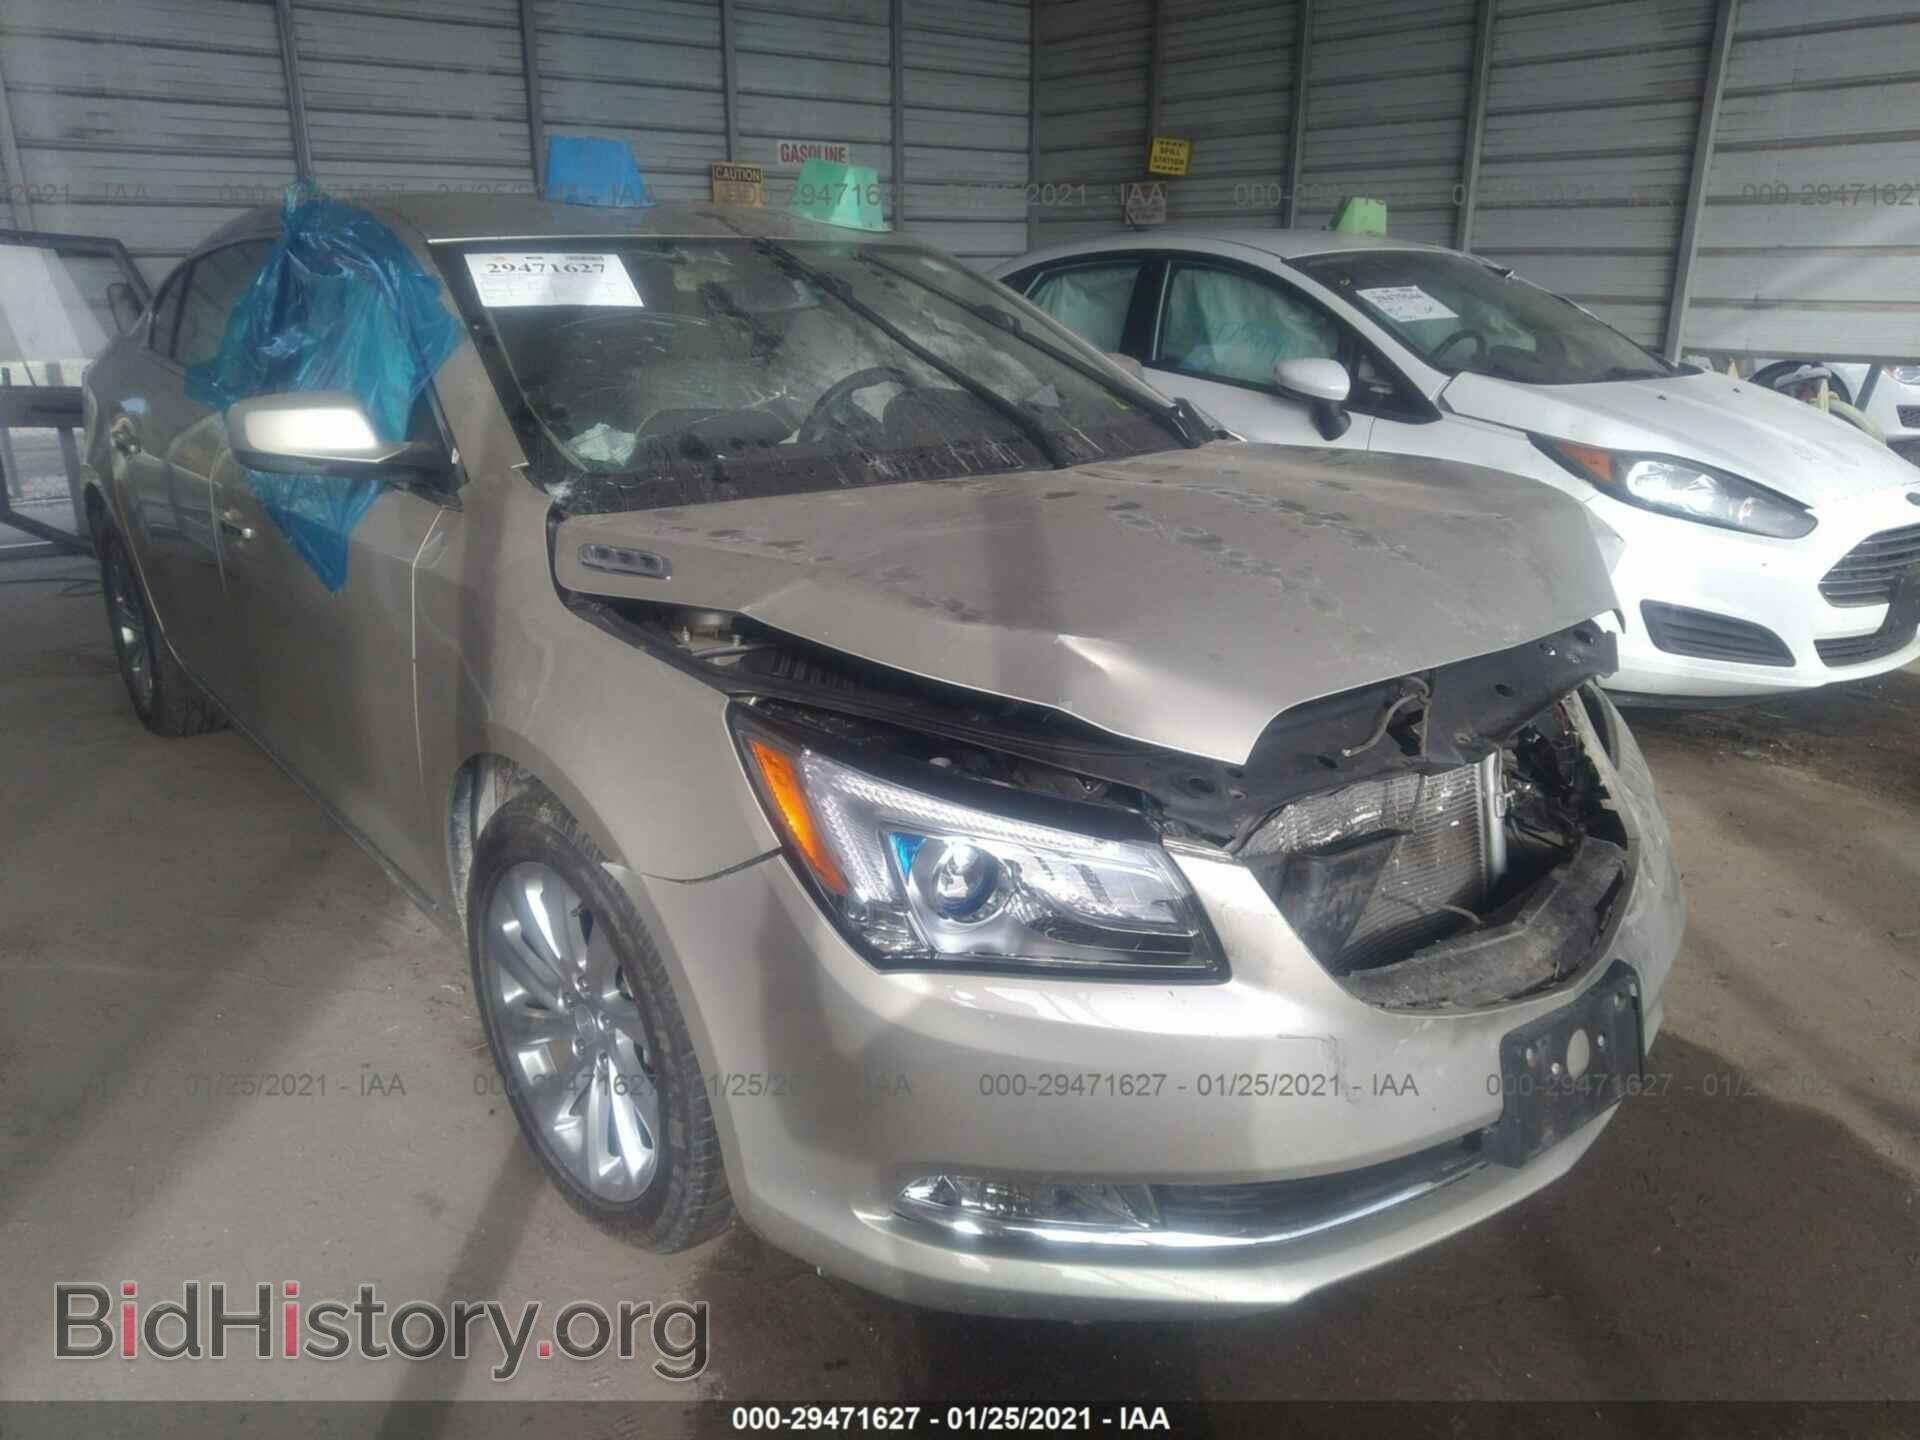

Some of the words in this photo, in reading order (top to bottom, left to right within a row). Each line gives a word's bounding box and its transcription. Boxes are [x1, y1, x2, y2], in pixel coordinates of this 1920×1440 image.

[779, 143, 848, 164] GASOLINE
[714, 167, 761, 182] CAUTION
[486, 263, 605, 273] 29471627
